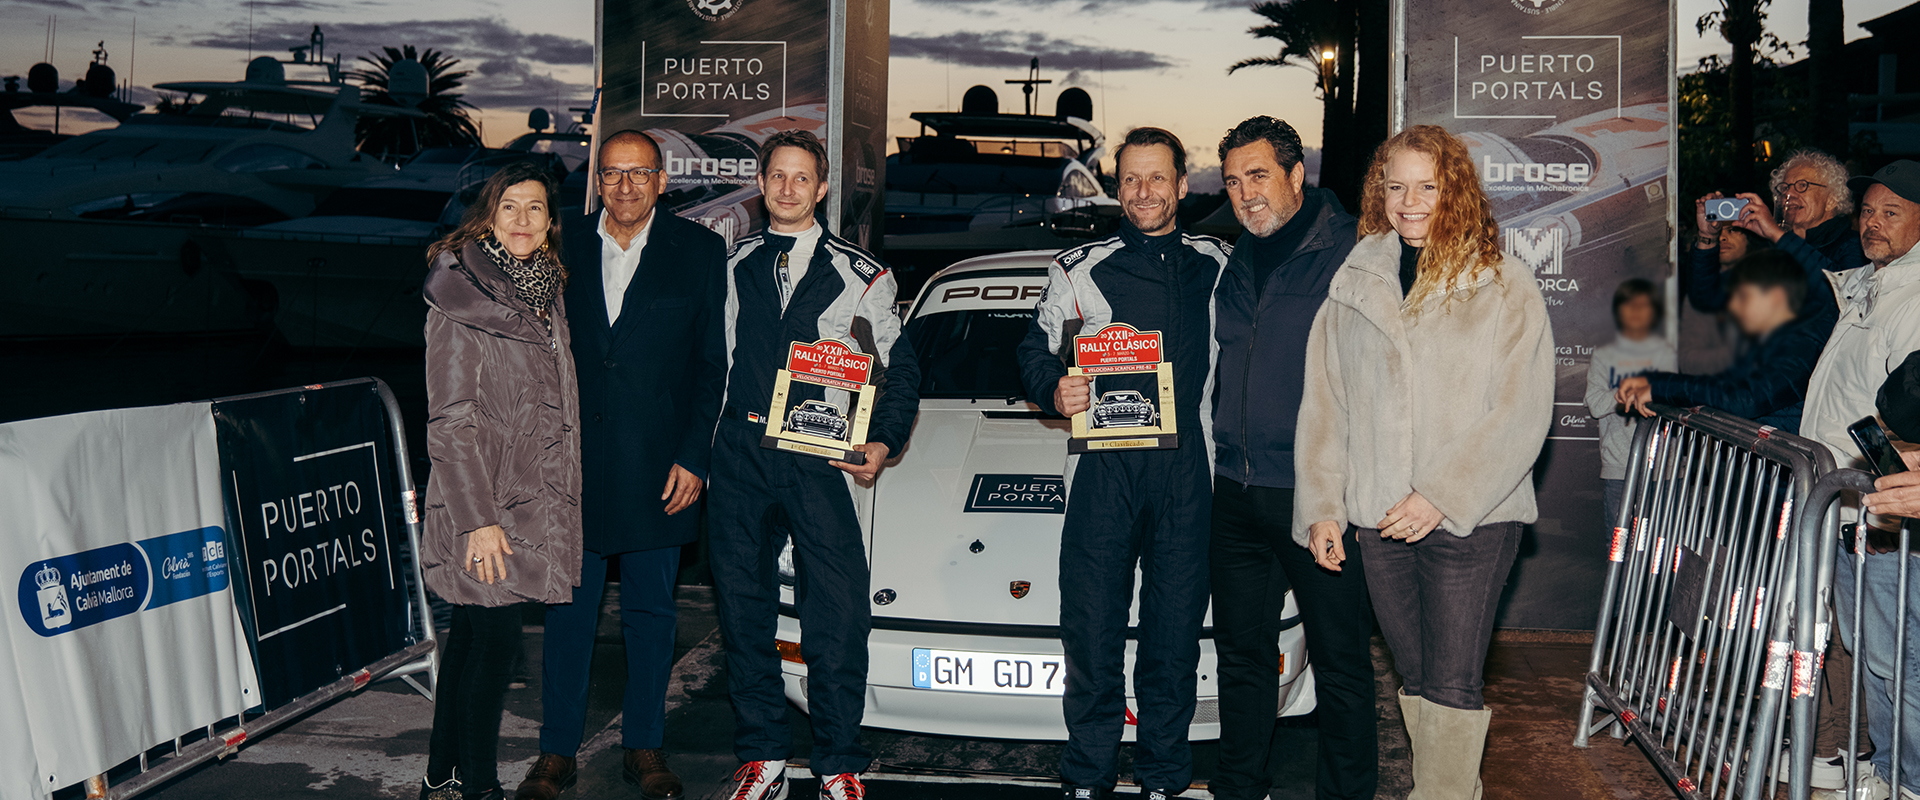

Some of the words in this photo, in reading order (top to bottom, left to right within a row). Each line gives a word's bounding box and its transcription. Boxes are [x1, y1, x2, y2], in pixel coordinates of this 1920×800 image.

[664, 58, 764, 76] PUERTO
[1480, 54, 1594, 73] PUERTO
[656, 82, 770, 101] PORTALS
[1472, 81, 1603, 100] PORTALS
[666, 150, 758, 177] brose
[1484, 155, 1589, 182] brose
[1484, 184, 1525, 192] Excellence
[1527, 184, 1534, 192] in
[1063, 249, 1084, 264] OMP
[855, 259, 876, 276] OMP
[1107, 330, 1128, 341] XXII
[822, 344, 843, 356] XXII
[1080, 341, 1110, 353] RALLY
[1113, 338, 1157, 351] CLÁSICO
[794, 349, 825, 363] RALLY
[825, 355, 868, 371] CLÁSICO
[810, 367, 827, 375] PUERTO
[827, 370, 846, 378] PORTALS
[1109, 440, 1145, 448] Clasificado
[998, 484, 1063, 492] PUER
[262, 480, 361, 539] PUERTO
[263, 528, 377, 597] PORTALS
[71, 563, 120, 592] Ajuntament
[121, 560, 132, 576] de
[76, 590, 99, 612] Calvià
[98, 585, 134, 606] Mallorca
[919, 672, 927, 682] D
[934, 656, 972, 686] GM
[994, 659, 1032, 689] GD
[1042, 662, 1059, 690] 7
